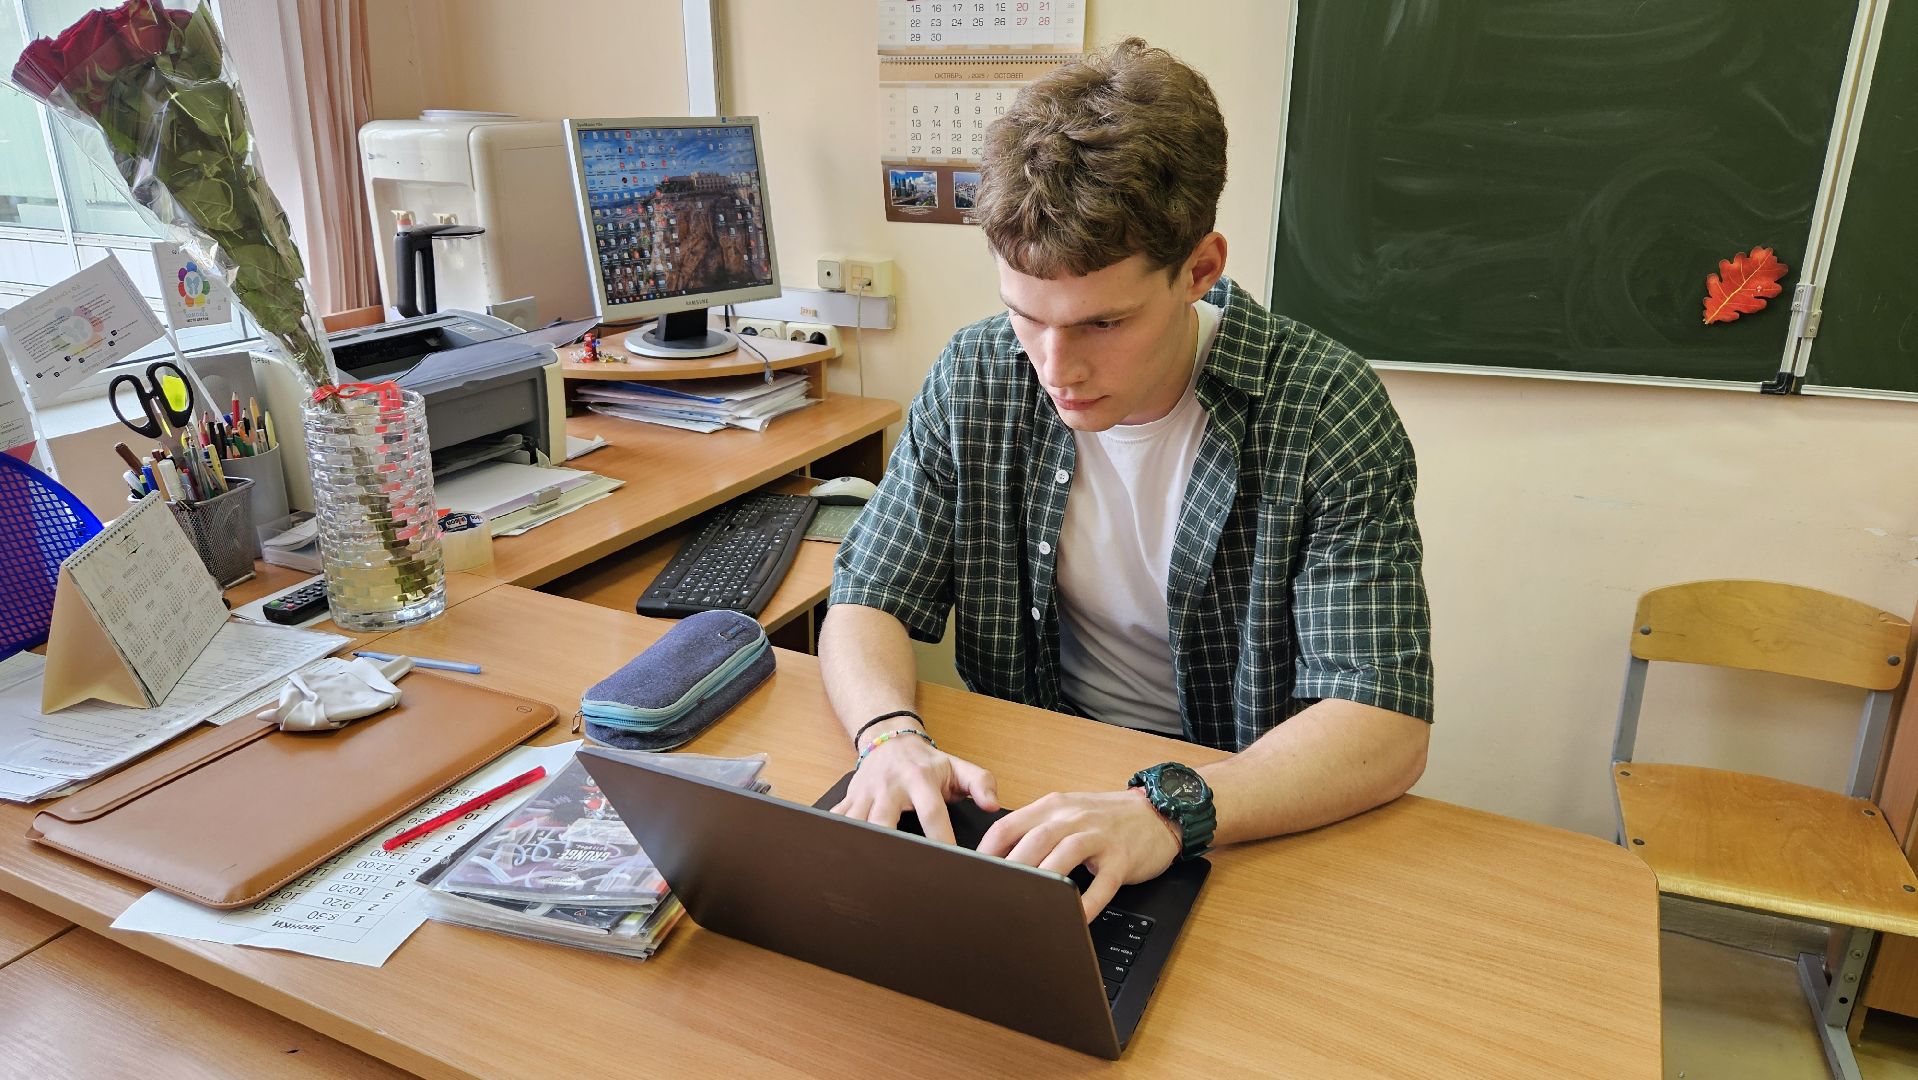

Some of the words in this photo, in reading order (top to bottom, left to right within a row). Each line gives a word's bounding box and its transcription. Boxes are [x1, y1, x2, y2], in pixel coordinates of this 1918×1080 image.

[911, 4, 921, 13] 15
[931, 4, 942, 13] 16
[953, 3, 963, 12] 17
[974, 3, 984, 12] 18
[1016, 2, 1029, 12] 20
[1039, 2, 1050, 11] 21
[911, 19, 921, 28] 22
[931, 18, 942, 27] 23
[951, 18, 962, 27] 24
[972, 18, 984, 27] 25
[994, 17, 1006, 26] 26
[1016, 17, 1028, 26] 27
[1038, 17, 1050, 26] 28
[910, 33, 921, 42] 29
[931, 33, 942, 42] 30
[955, 92, 959, 101] 1
[975, 92, 981, 101] 2
[996, 92, 1002, 101] 3
[912, 105, 919, 114] 6
[933, 105, 939, 114] 7
[954, 106, 960, 115] 8
[974, 106, 981, 115] 9
[993, 106, 1005, 115] 10
[911, 119, 921, 128] 13
[931, 119, 941, 128] 14
[952, 120, 962, 129] 15
[973, 120, 982, 128] 16
[910, 132, 921, 141] 20
[931, 132, 941, 141] 21
[951, 133, 962, 142] 22
[971, 134, 982, 142] 23
[911, 146, 921, 154] 27
[931, 146, 941, 155] 28
[951, 147, 962, 155] 29
[442, 787, 476, 797] 18:00
[464, 812, 480, 820] 10
[456, 823, 467, 831] 9
[444, 834, 456, 842] 8
[432, 845, 444, 853] 7
[370, 849, 408, 860] 13:00
[559, 849, 611, 862] GRUNGE
[420, 856, 432, 864] 6
[356, 860, 396, 871] 12:00
[408, 867, 420, 876] 5
[342, 872, 381, 883] 11:10
[395, 879, 406, 888] 4
[328, 883, 369, 896] 10:20
[382, 892, 394, 900] 3
[253, 902, 286, 913] 9:10
[322, 897, 355, 910] 9:20
[367, 903, 380, 911] 2
[307, 910, 340, 921] 8:30
[354, 915, 365, 924] 1
[272, 919, 326, 933] Звонки
